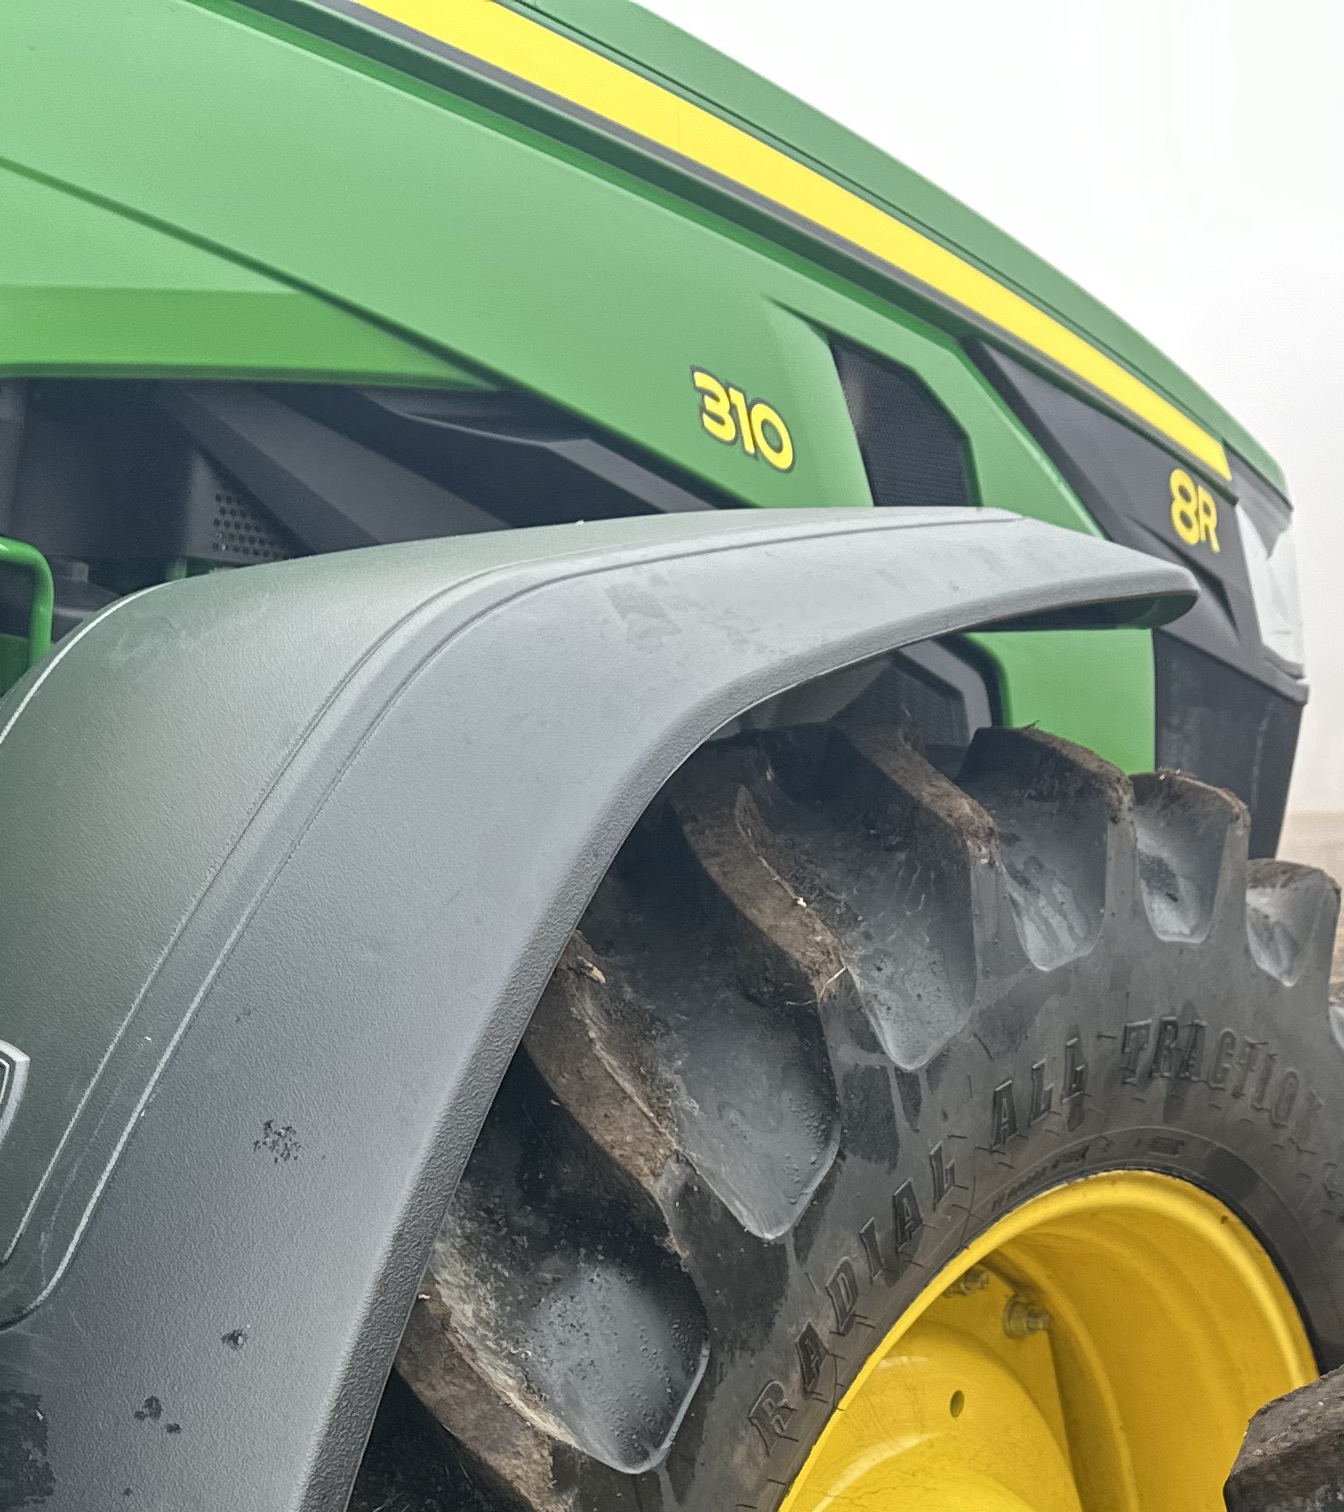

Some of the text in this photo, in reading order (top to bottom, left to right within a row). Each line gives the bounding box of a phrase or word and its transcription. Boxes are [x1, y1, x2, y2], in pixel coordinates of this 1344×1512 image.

[692, 368, 795, 472] 310
[1169, 468, 1221, 553] 8R
[749, 1141, 958, 1456] RADIAL
[990, 1036, 1087, 1152] ALL
